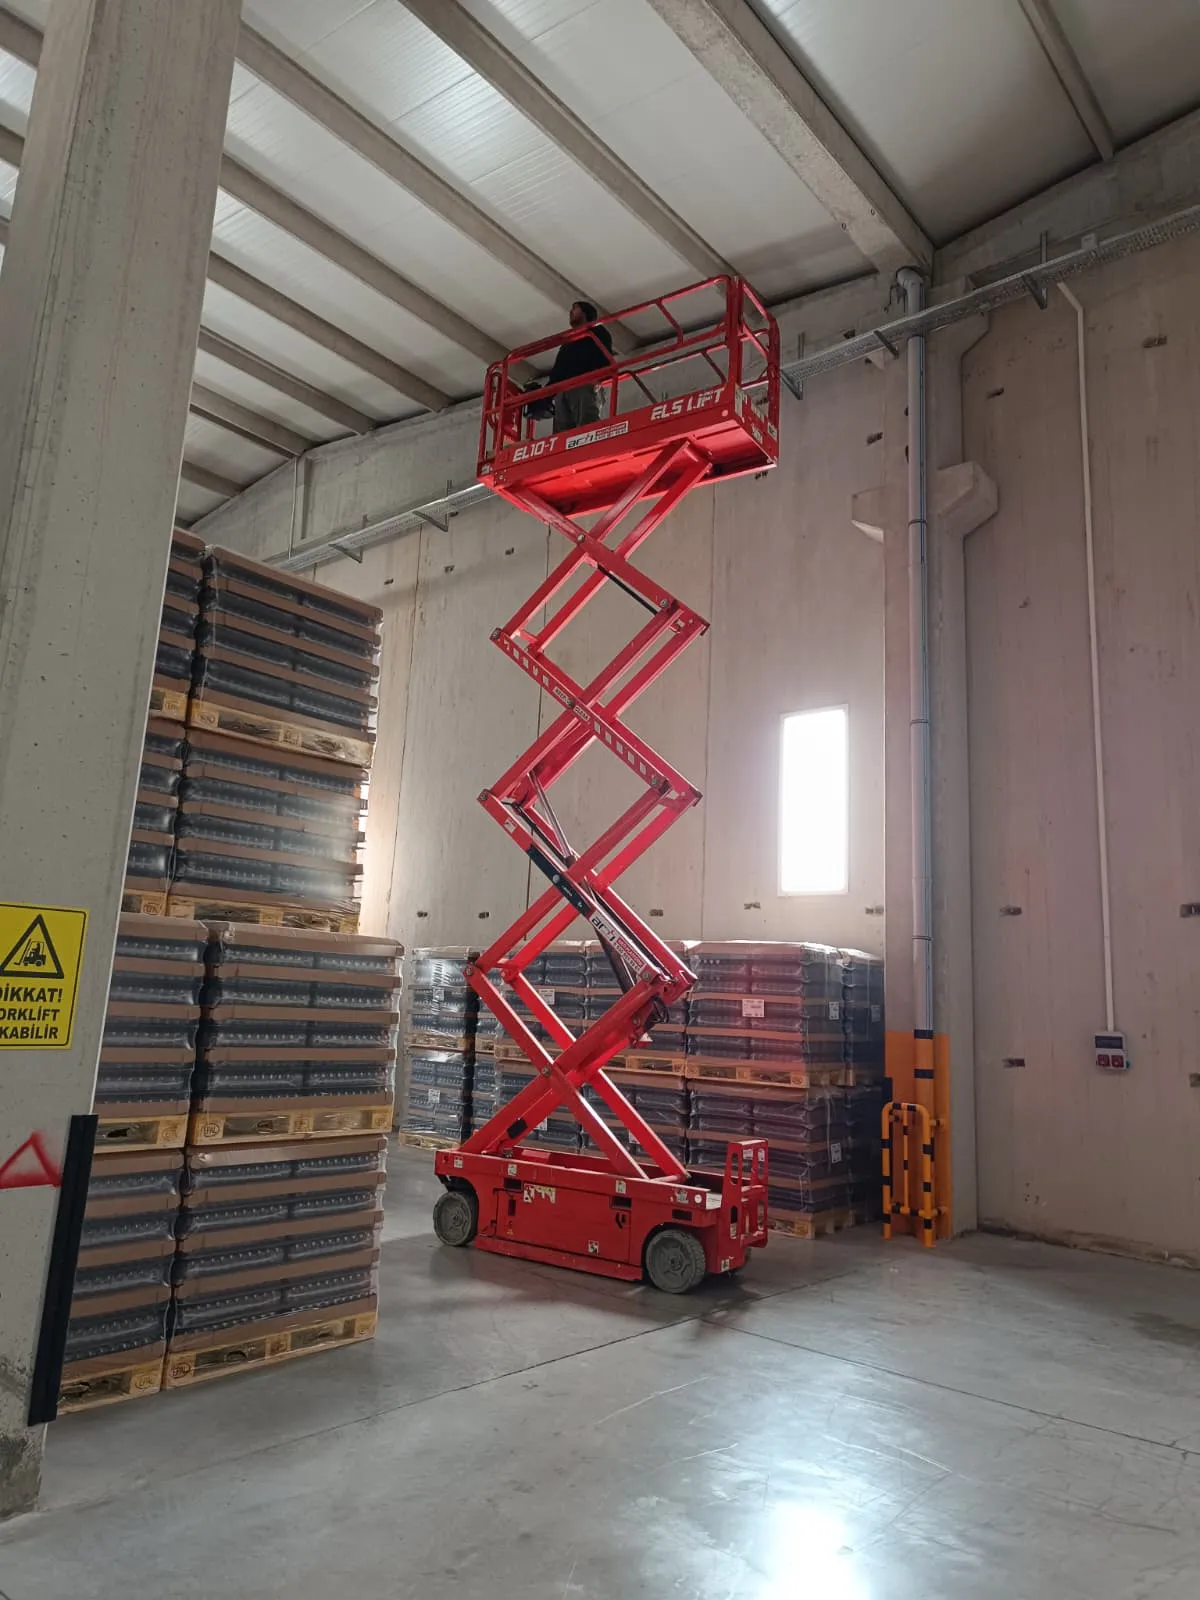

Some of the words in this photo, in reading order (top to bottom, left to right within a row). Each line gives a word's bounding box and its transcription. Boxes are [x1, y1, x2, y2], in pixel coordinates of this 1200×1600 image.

[651, 399, 685, 421] ELS
[686, 387, 725, 413] LIFT
[512, 437, 559, 463] EL10-T
